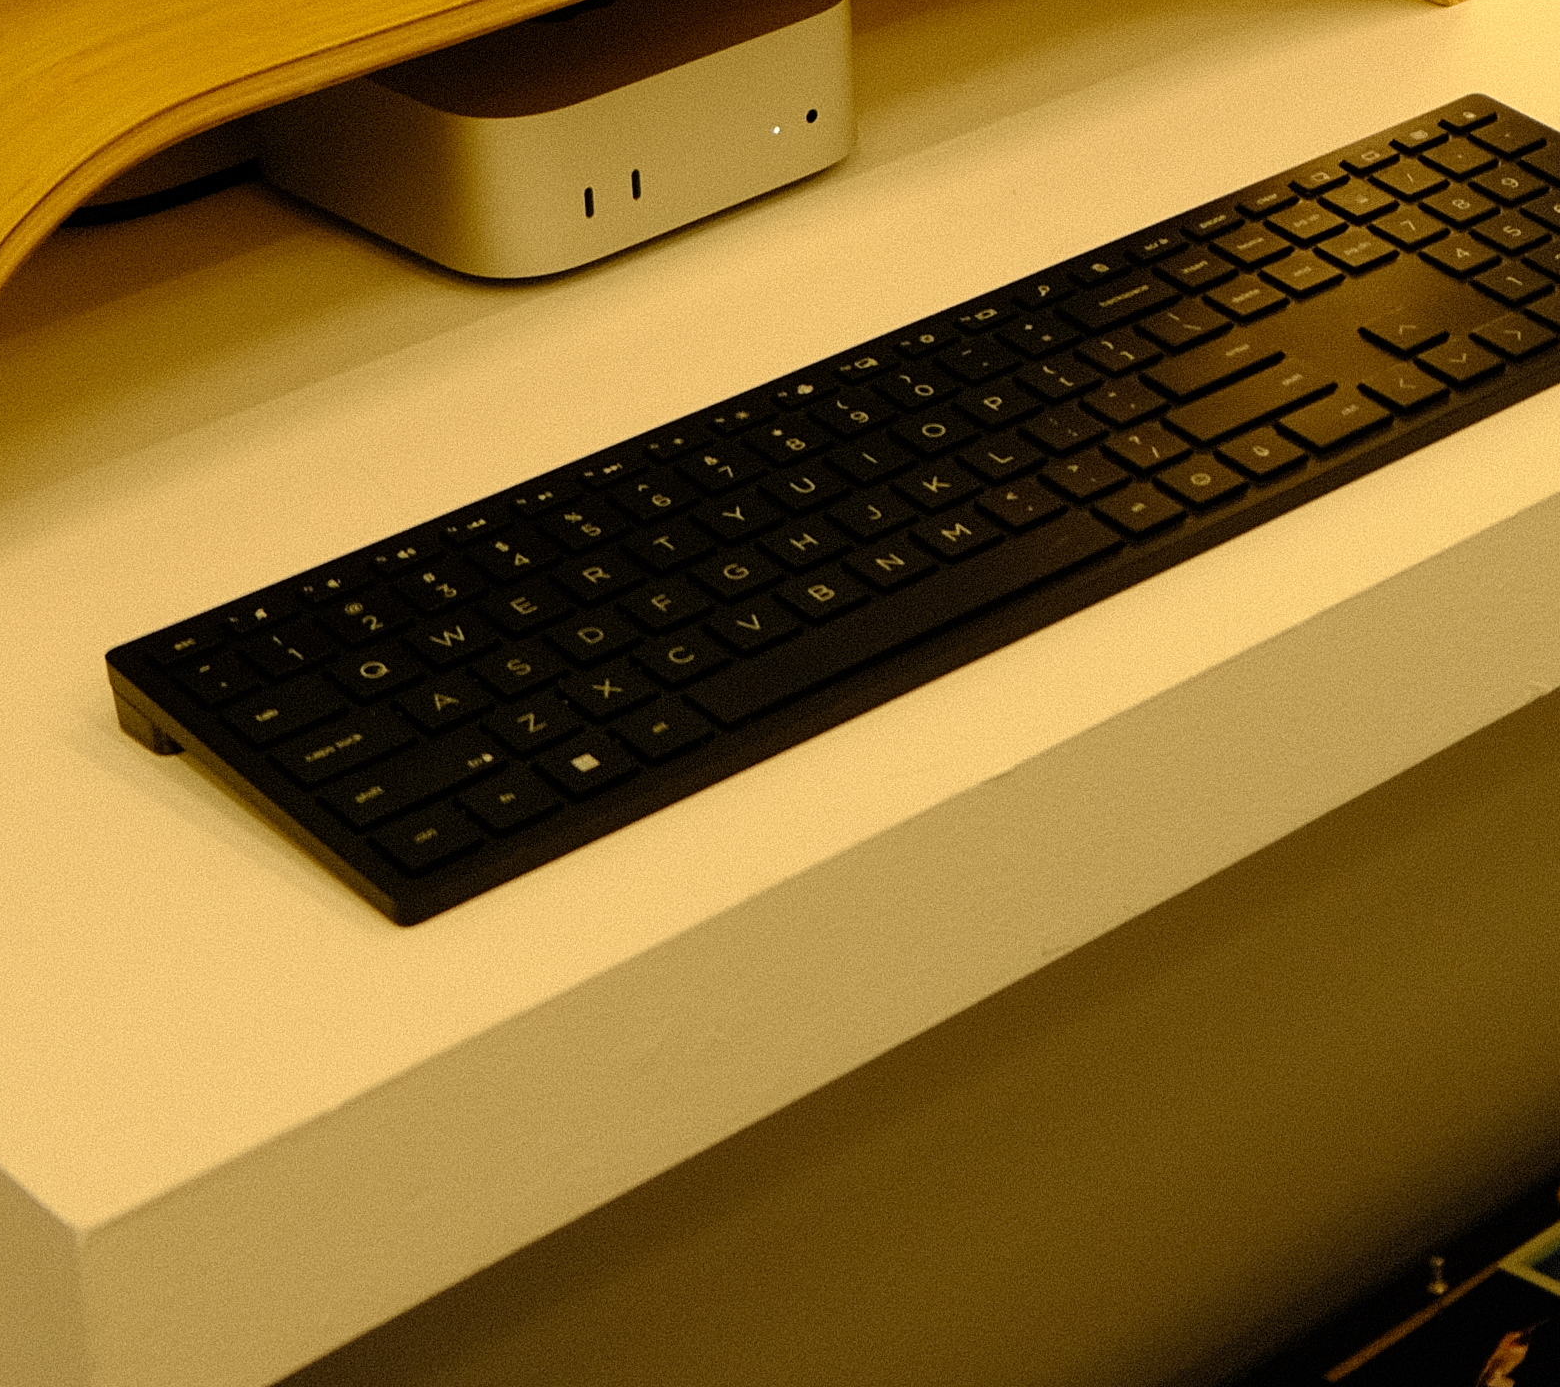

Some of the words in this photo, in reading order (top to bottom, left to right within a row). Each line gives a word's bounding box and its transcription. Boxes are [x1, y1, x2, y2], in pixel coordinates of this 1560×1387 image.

[359, 661, 389, 679] Q
[431, 626, 465, 647] W
[510, 597, 538, 615] E
[582, 566, 610, 583] R
[653, 535, 675, 551] T
[723, 506, 745, 521] Y
[789, 477, 816, 494] U
[921, 423, 947, 438] O
[982, 396, 1003, 411] P
[433, 693, 458, 711] A
[506, 658, 532, 676] S
[577, 627, 605, 645] D
[650, 594, 671, 612] F
[722, 563, 750, 580] G
[790, 533, 818, 551] H
[867, 504, 883, 520] J
[923, 476, 950, 493] K
[988, 452, 1014, 465] L
[518, 712, 545, 733] Z
[593, 679, 622, 698] X
[667, 646, 695, 664] C
[737, 614, 761, 631] V
[807, 584, 836, 602] B
[875, 553, 905, 571] N
[941, 522, 972, 542] M
